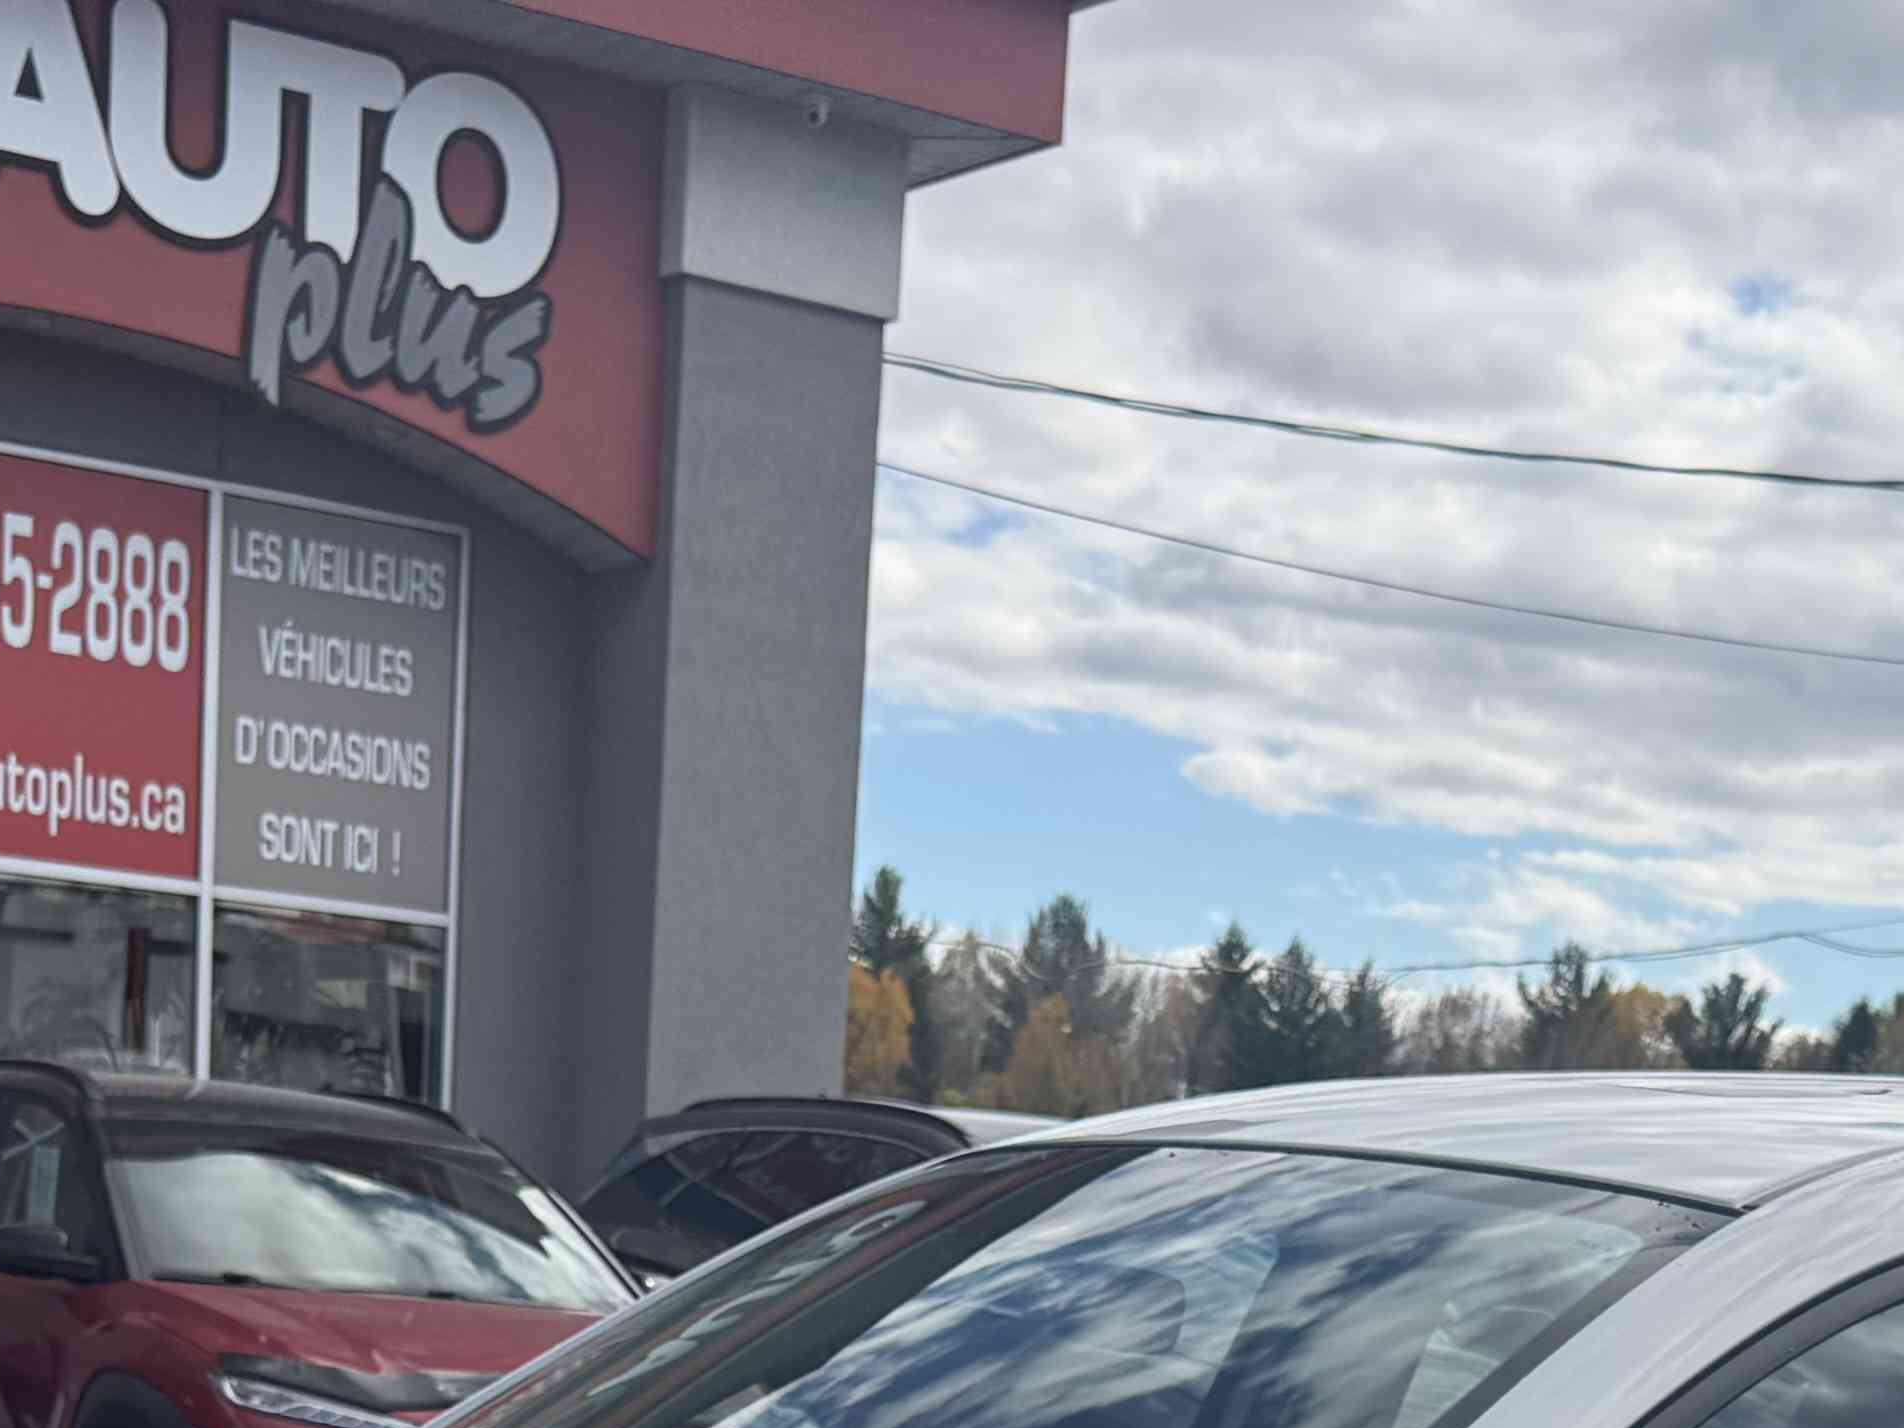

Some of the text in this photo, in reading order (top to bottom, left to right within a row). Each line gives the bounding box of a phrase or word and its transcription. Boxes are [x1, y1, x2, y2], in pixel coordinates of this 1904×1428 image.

[246, 176, 554, 426] plus
[229, 526, 446, 611] LES MEILLEURS
[258, 619, 413, 697] VÉHICULES
[258, 812, 340, 868] SONT
[343, 824, 379, 874] ICI
